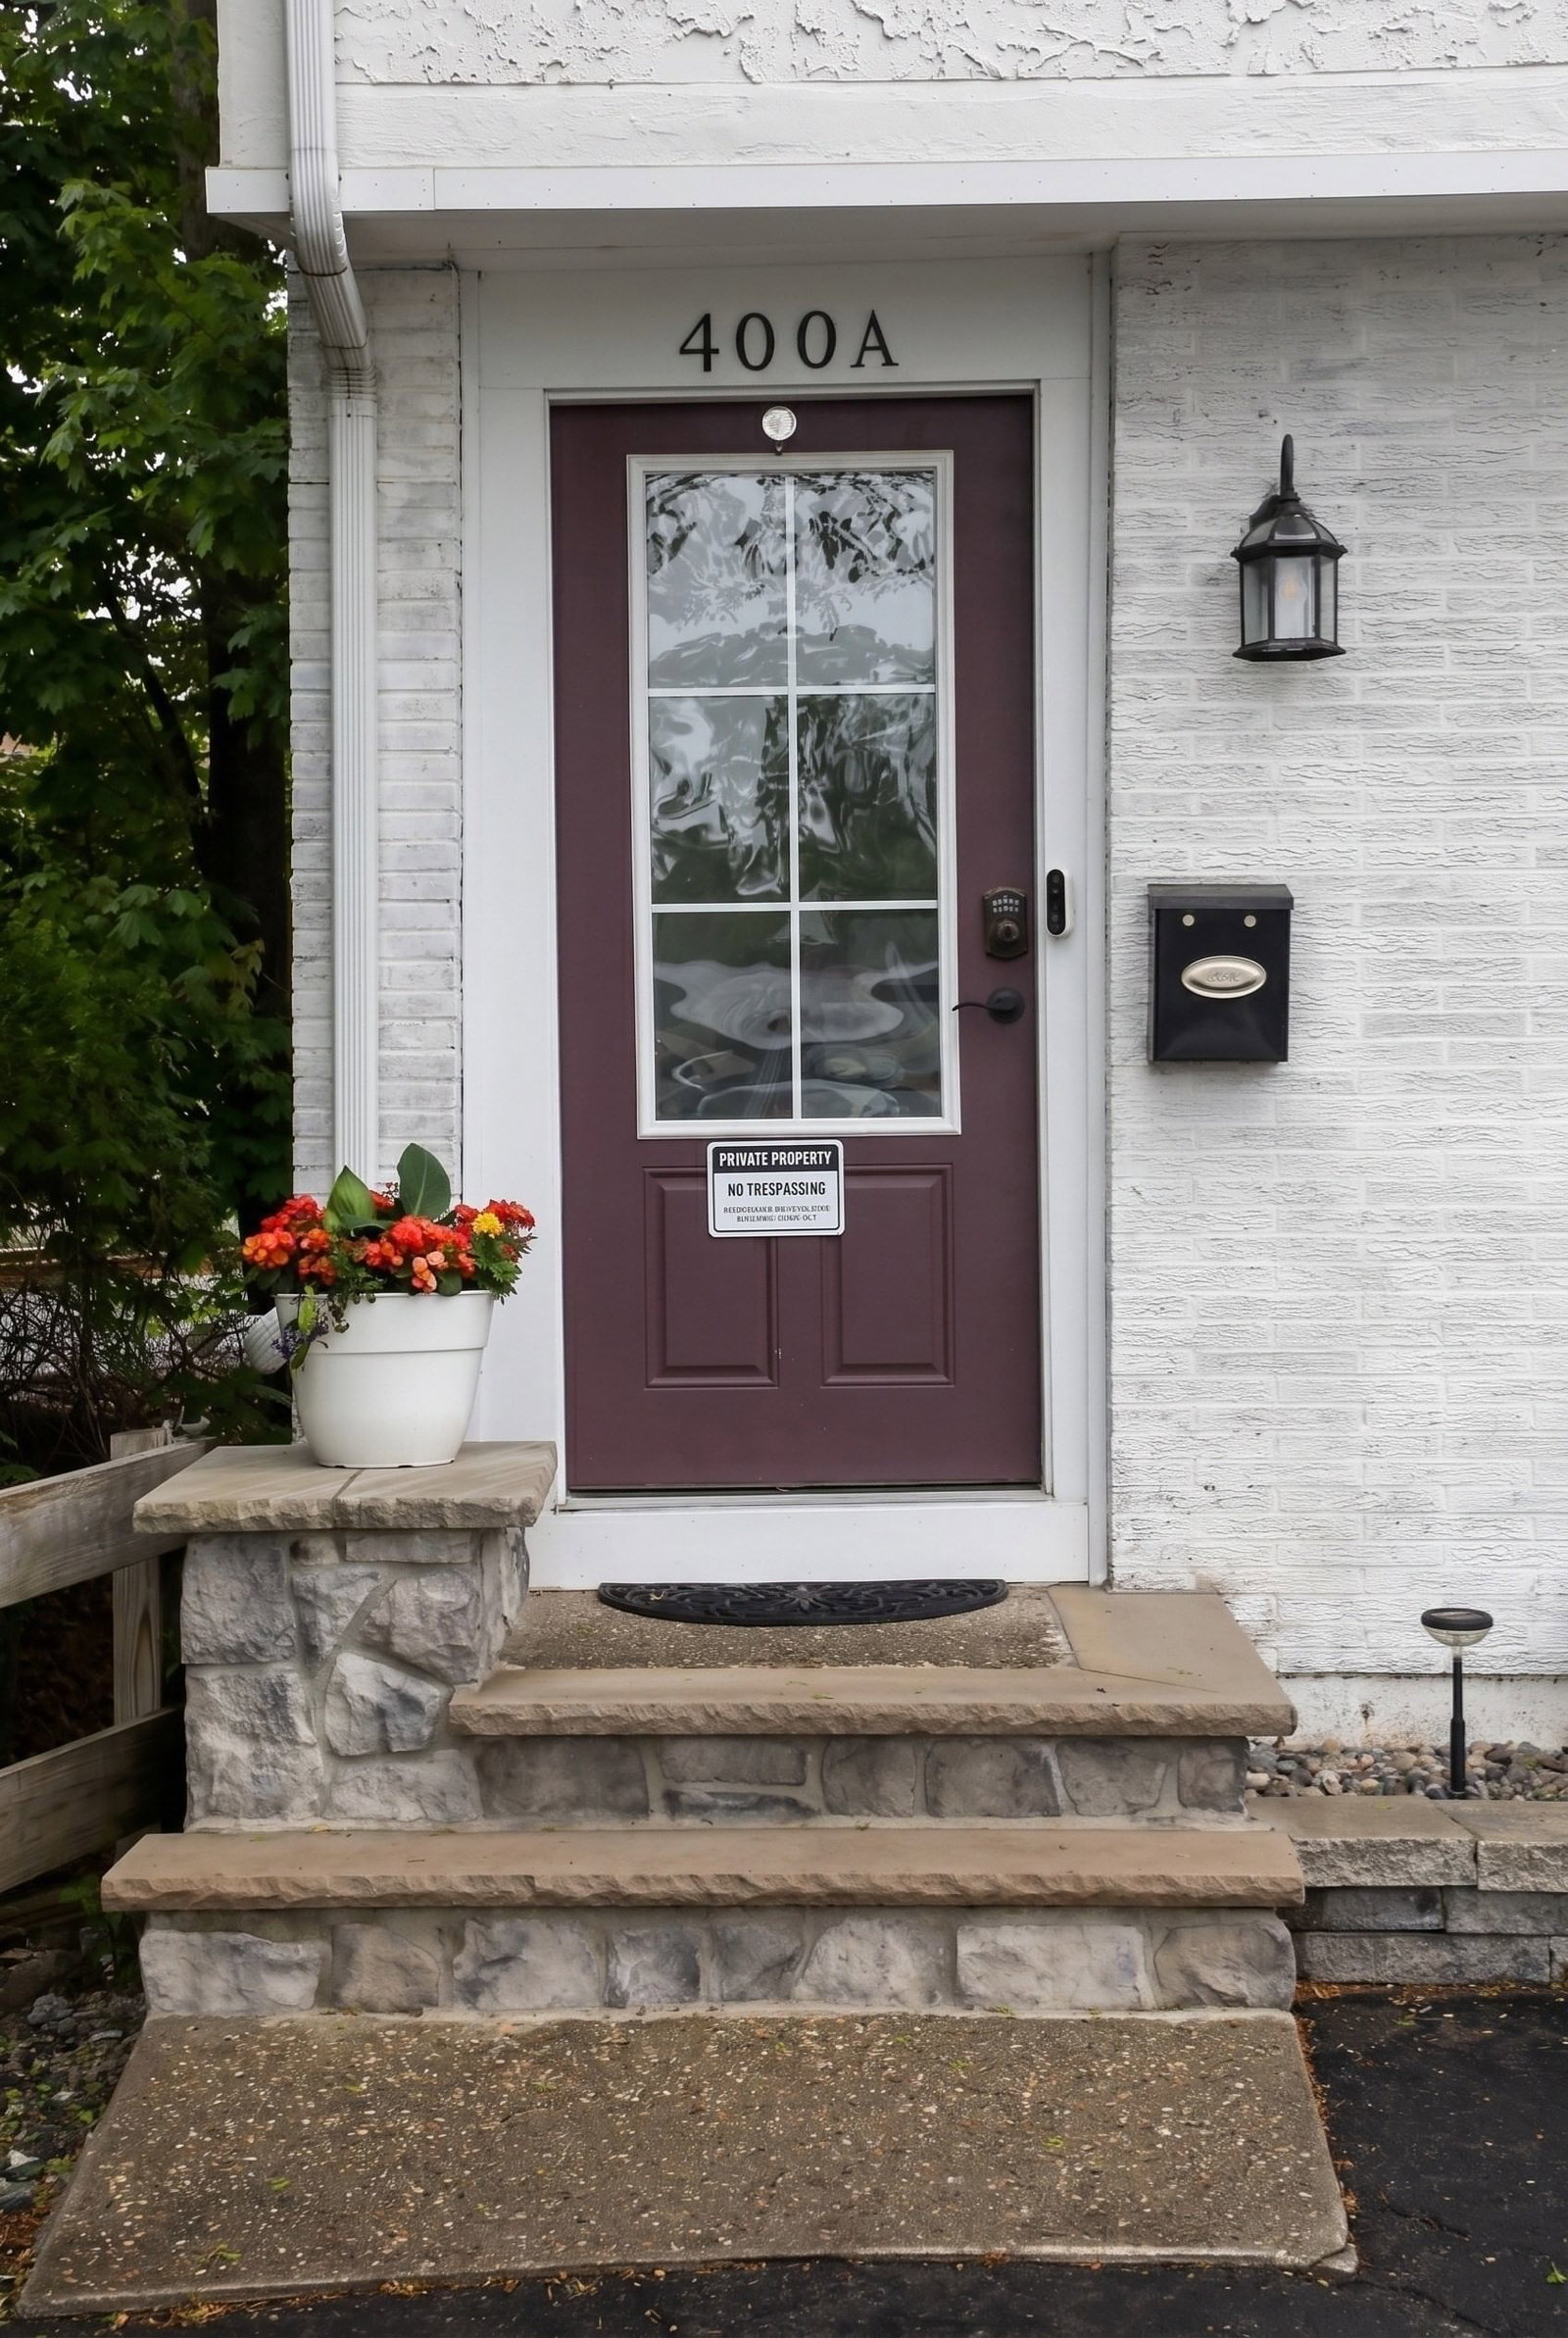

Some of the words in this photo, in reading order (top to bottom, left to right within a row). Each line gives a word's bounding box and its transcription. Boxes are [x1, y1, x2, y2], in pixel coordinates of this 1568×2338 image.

[679, 309, 899, 373] 400A
[719, 1152, 768, 1167] PRIVATE
[771, 1151, 832, 1166] PROPERTY
[728, 1183, 744, 1197] NO
[747, 1181, 826, 1196] TRESPASSING
